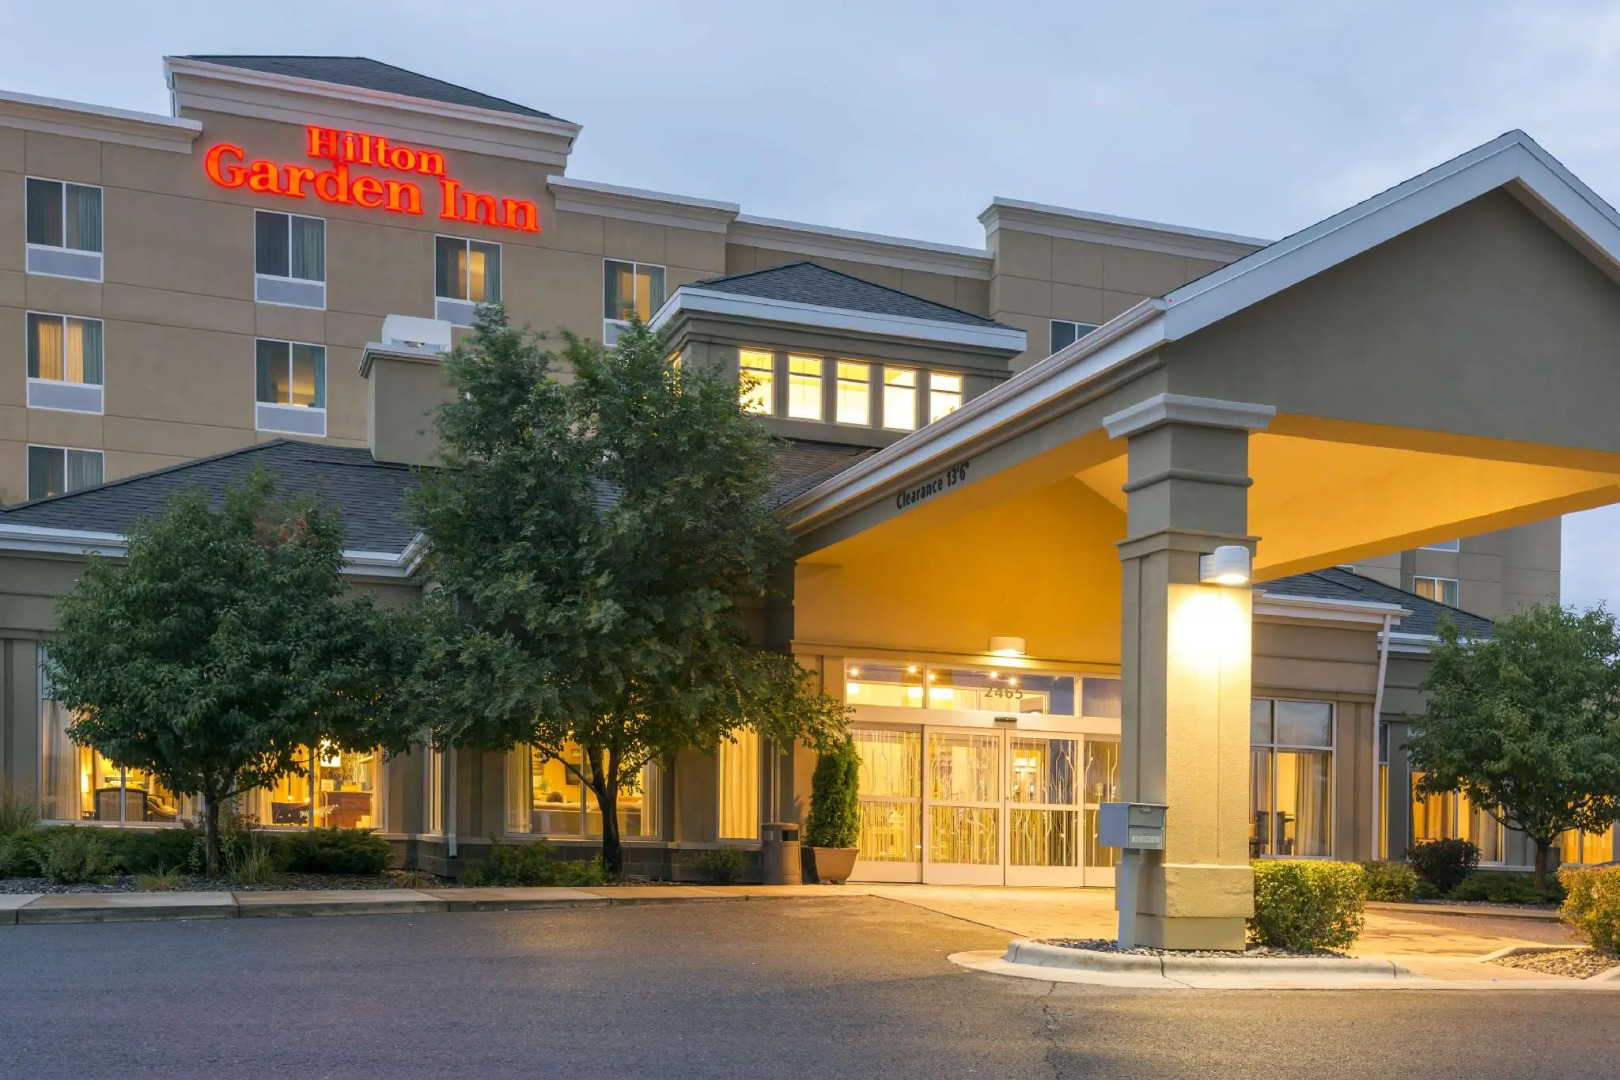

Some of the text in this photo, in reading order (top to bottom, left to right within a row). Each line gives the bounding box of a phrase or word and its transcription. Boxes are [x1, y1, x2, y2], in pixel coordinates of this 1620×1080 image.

[306, 125, 446, 176] Hilton
[205, 144, 540, 232] Garden Inn
[896, 461, 970, 510] Clearance 13'6"
[984, 683, 1023, 699] 2465
